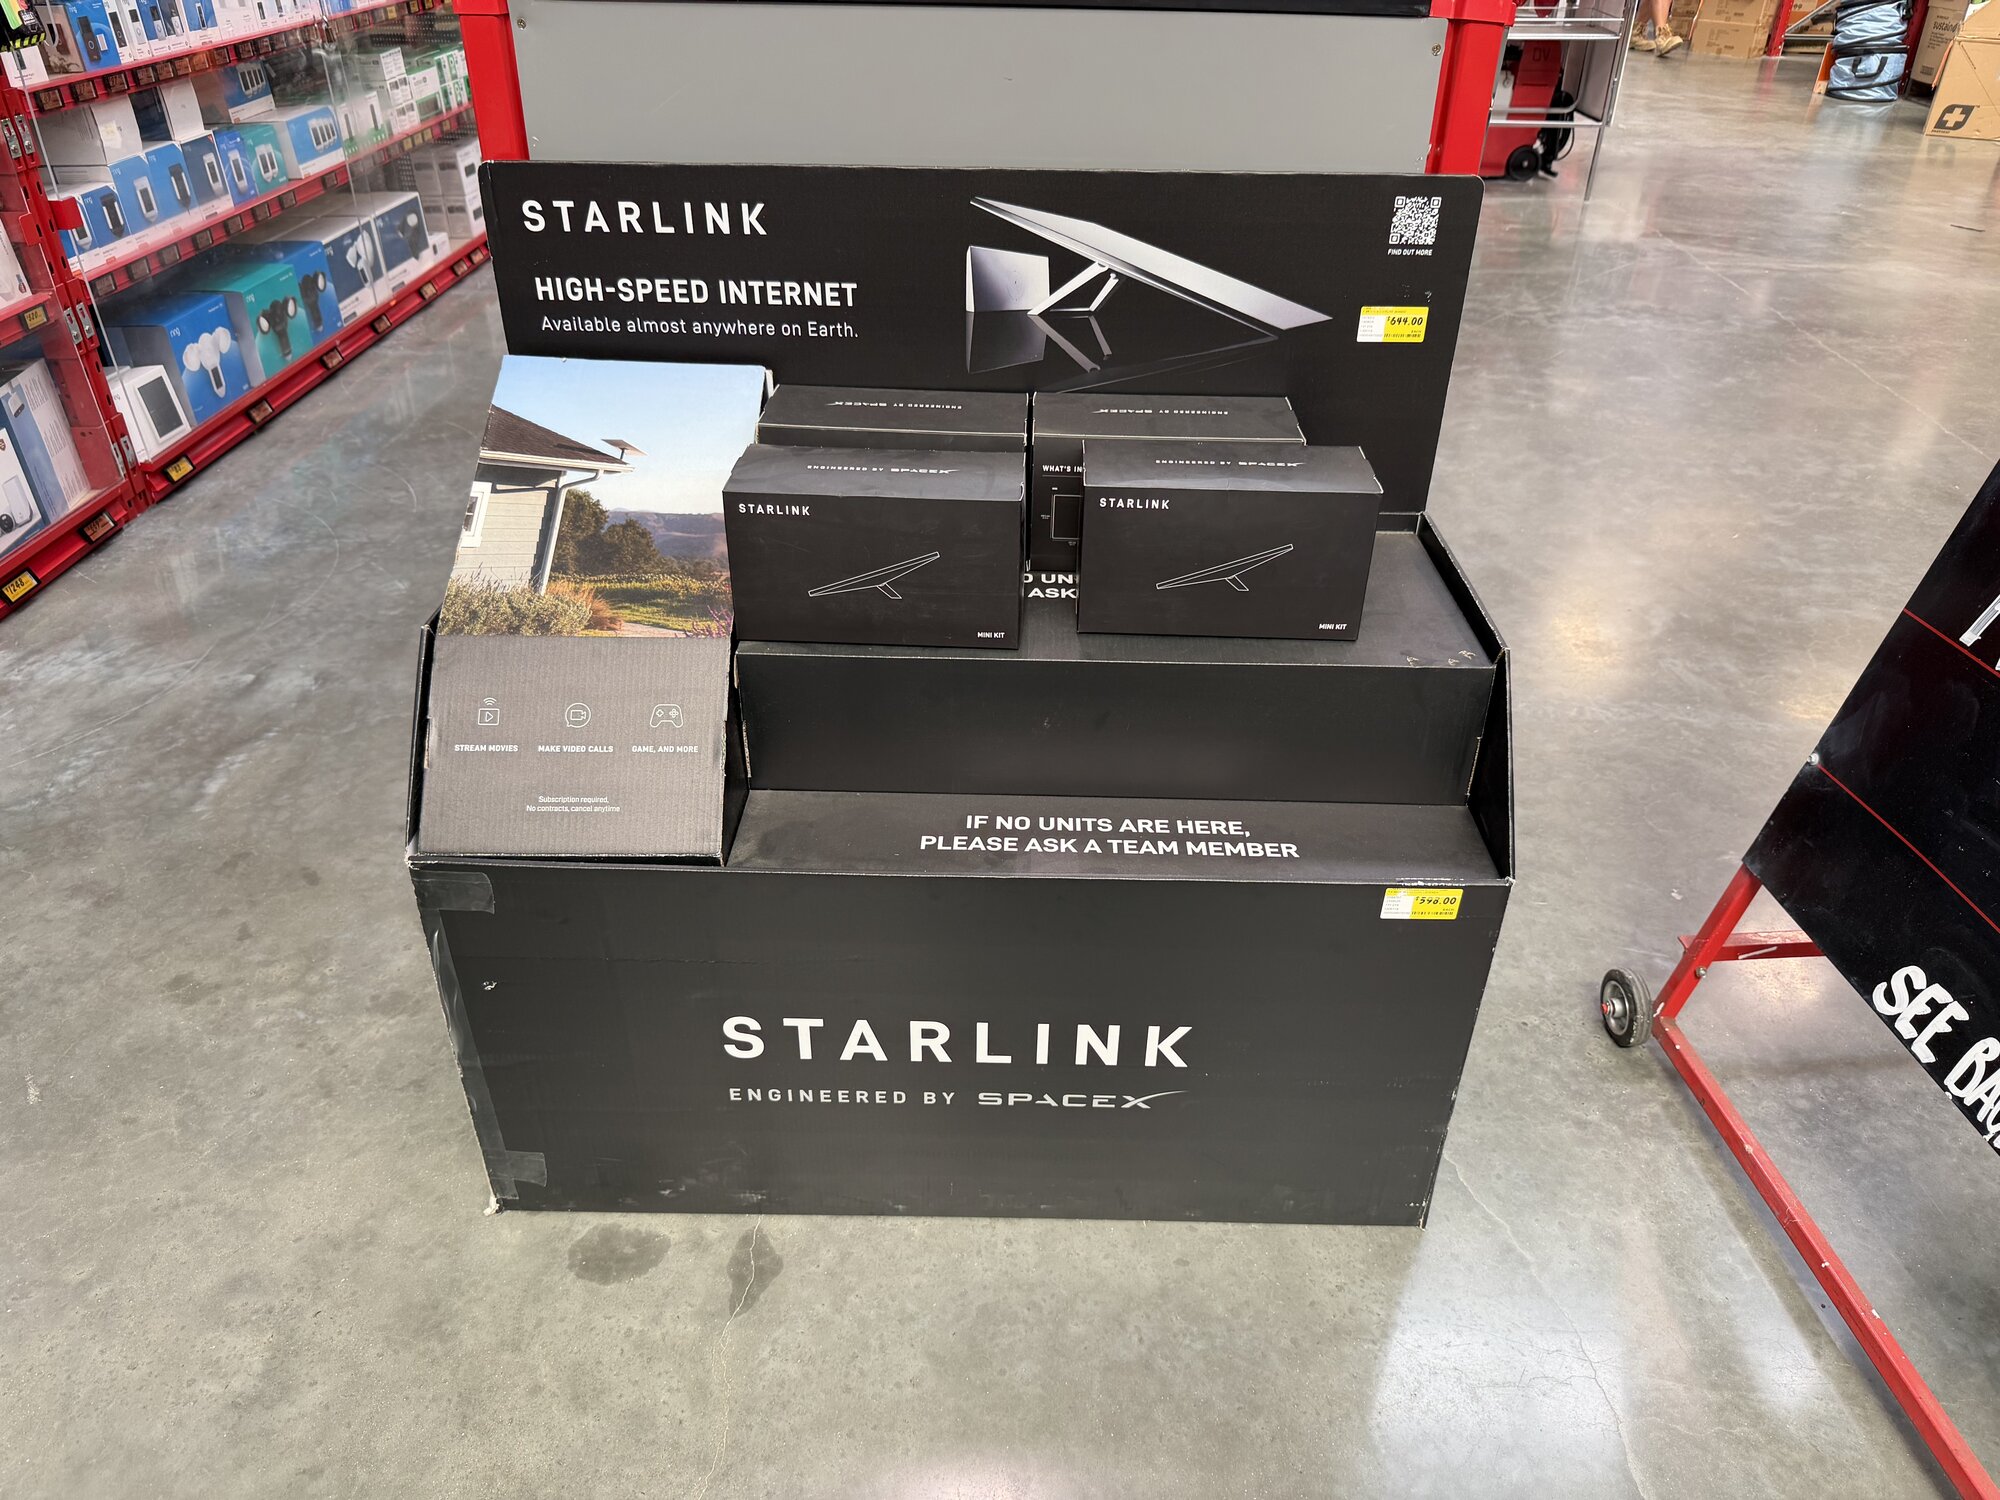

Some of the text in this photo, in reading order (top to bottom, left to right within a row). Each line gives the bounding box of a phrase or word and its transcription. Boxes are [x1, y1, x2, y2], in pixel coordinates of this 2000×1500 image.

[521, 199, 767, 236] STARLINK
[1387, 248, 1402, 256] FIND
[1402, 248, 1415, 256] OUT
[534, 277, 858, 307] HIGH-SPEED INTERNET
[541, 315, 858, 338] Available almost anywhere on Earth.
[1387, 316, 1424, 326] $644.00
[169, 326, 182, 338] ring
[1042, 464, 1071, 473] WHAT'S
[738, 503, 810, 516] STARLINK
[1099, 497, 1170, 510] STARLINK
[454, 744, 519, 752] STREAM MOVIES
[537, 745, 614, 753] MAKE VIDEO CALLS
[631, 745, 699, 754] GAME, AND MORE
[538, 795, 580, 804] Subscription
[526, 804, 621, 813] No contracts, cancel anytime
[966, 814, 1251, 838] IF NO UNITS ARE HERE,
[920, 835, 1300, 858] PLEASE ASK A TEAM MEMBER
[1872, 965, 1970, 1064] SEE
[722, 1016, 1193, 1068] STARLINK
[729, 1087, 1188, 1109] ENGINEERED BY SPACEX
